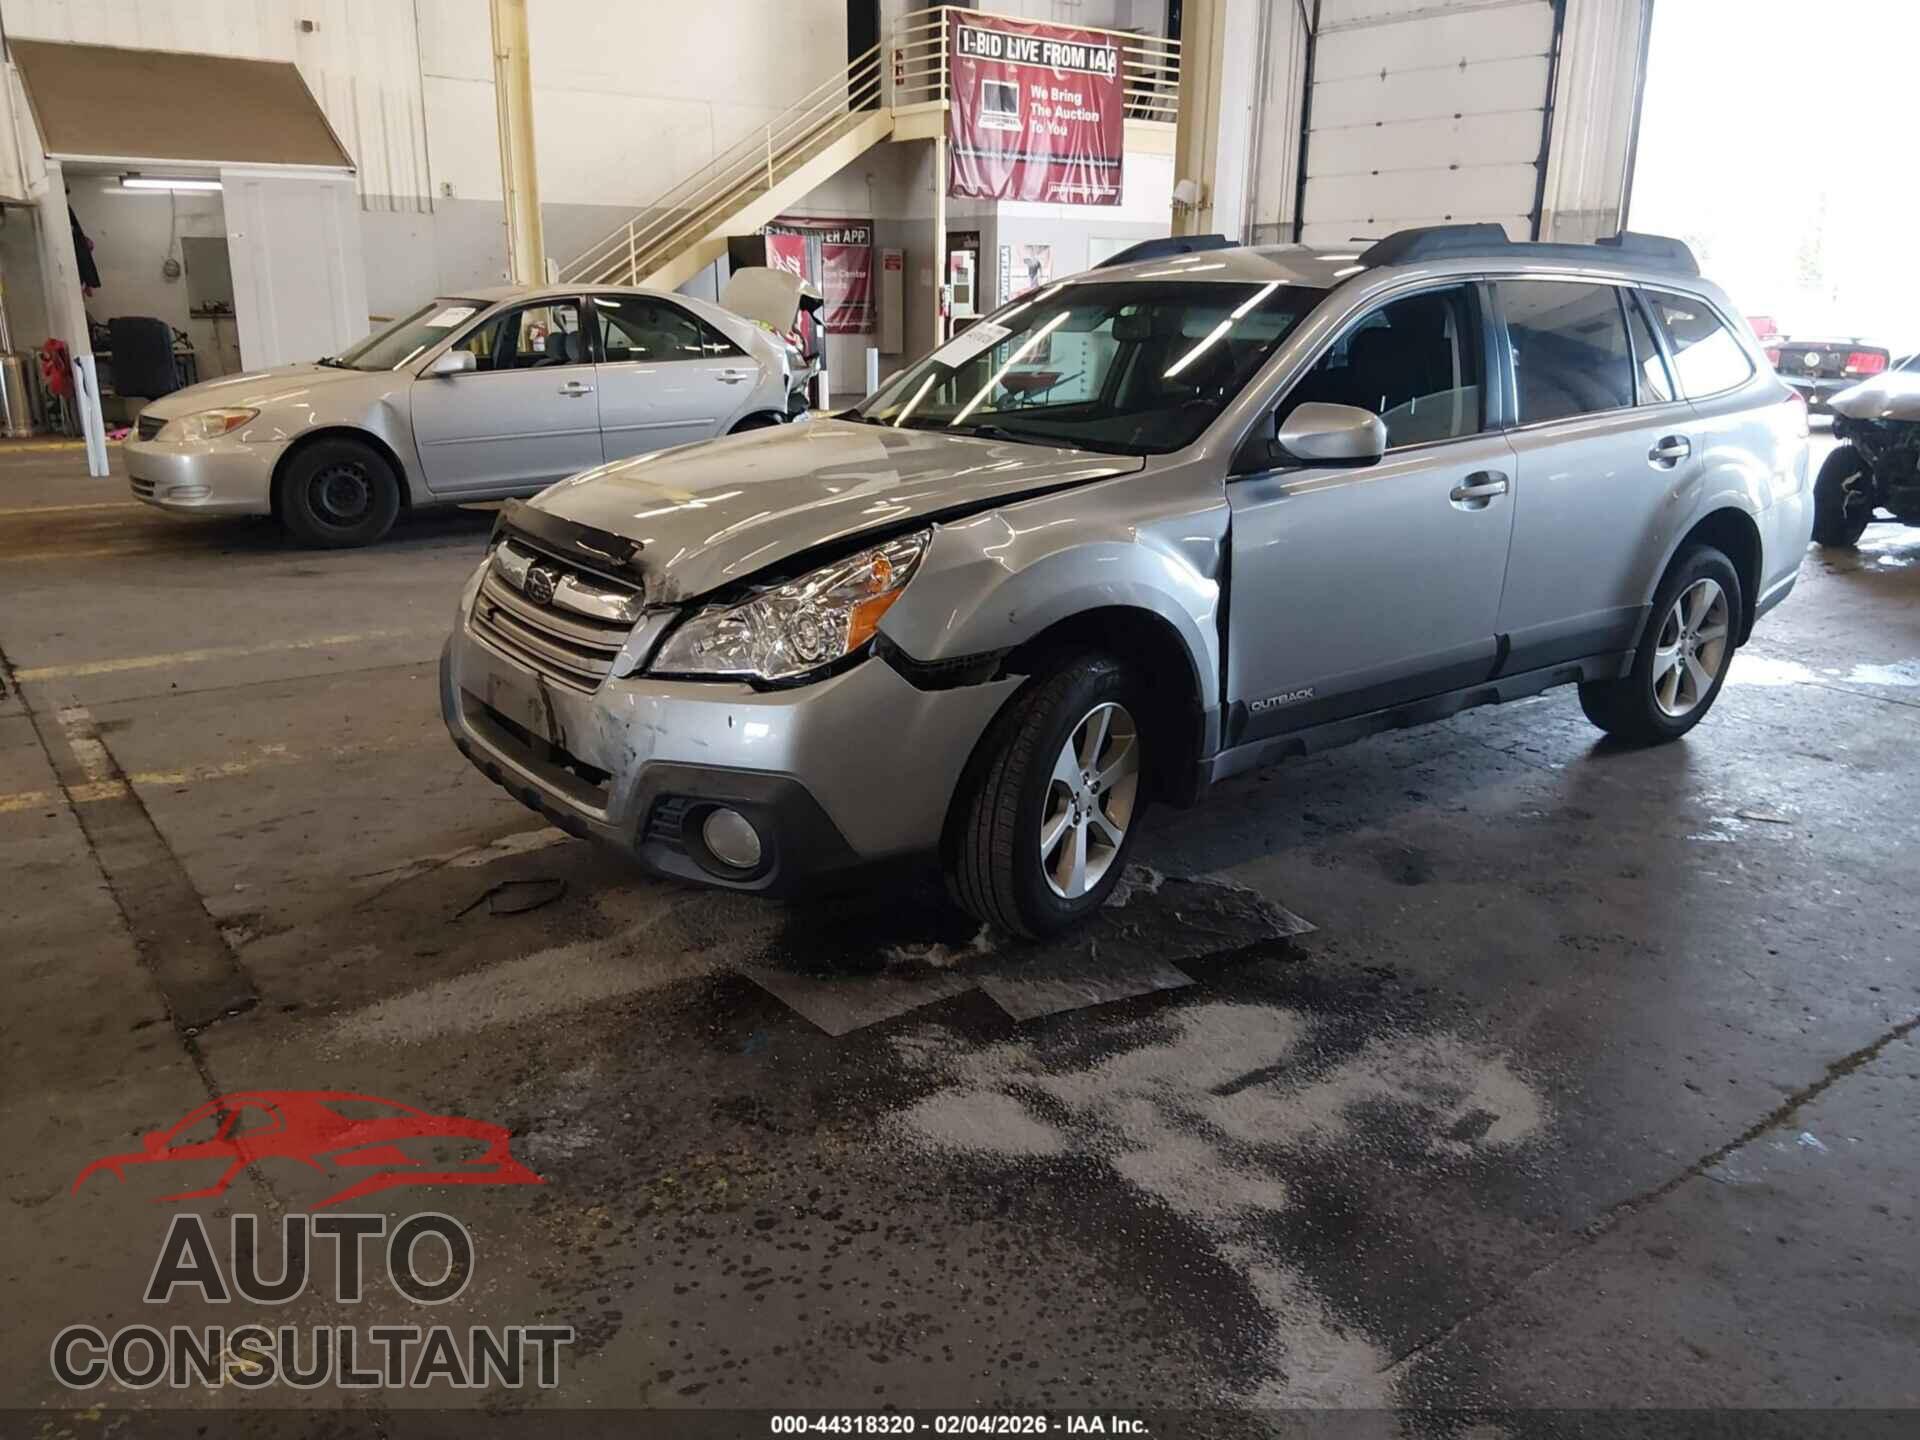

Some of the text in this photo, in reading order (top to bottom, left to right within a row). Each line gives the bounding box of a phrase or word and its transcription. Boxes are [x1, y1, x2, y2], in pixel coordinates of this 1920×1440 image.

[963, 30, 1117, 75] I-BID LIVE FROM IAA
[1030, 84, 1083, 106] We Bring
[1030, 102, 1100, 122] The Auction
[1030, 120, 1068, 136] To You
[843, 229, 865, 243] APP
[1251, 687, 1313, 711] OUTBACK
